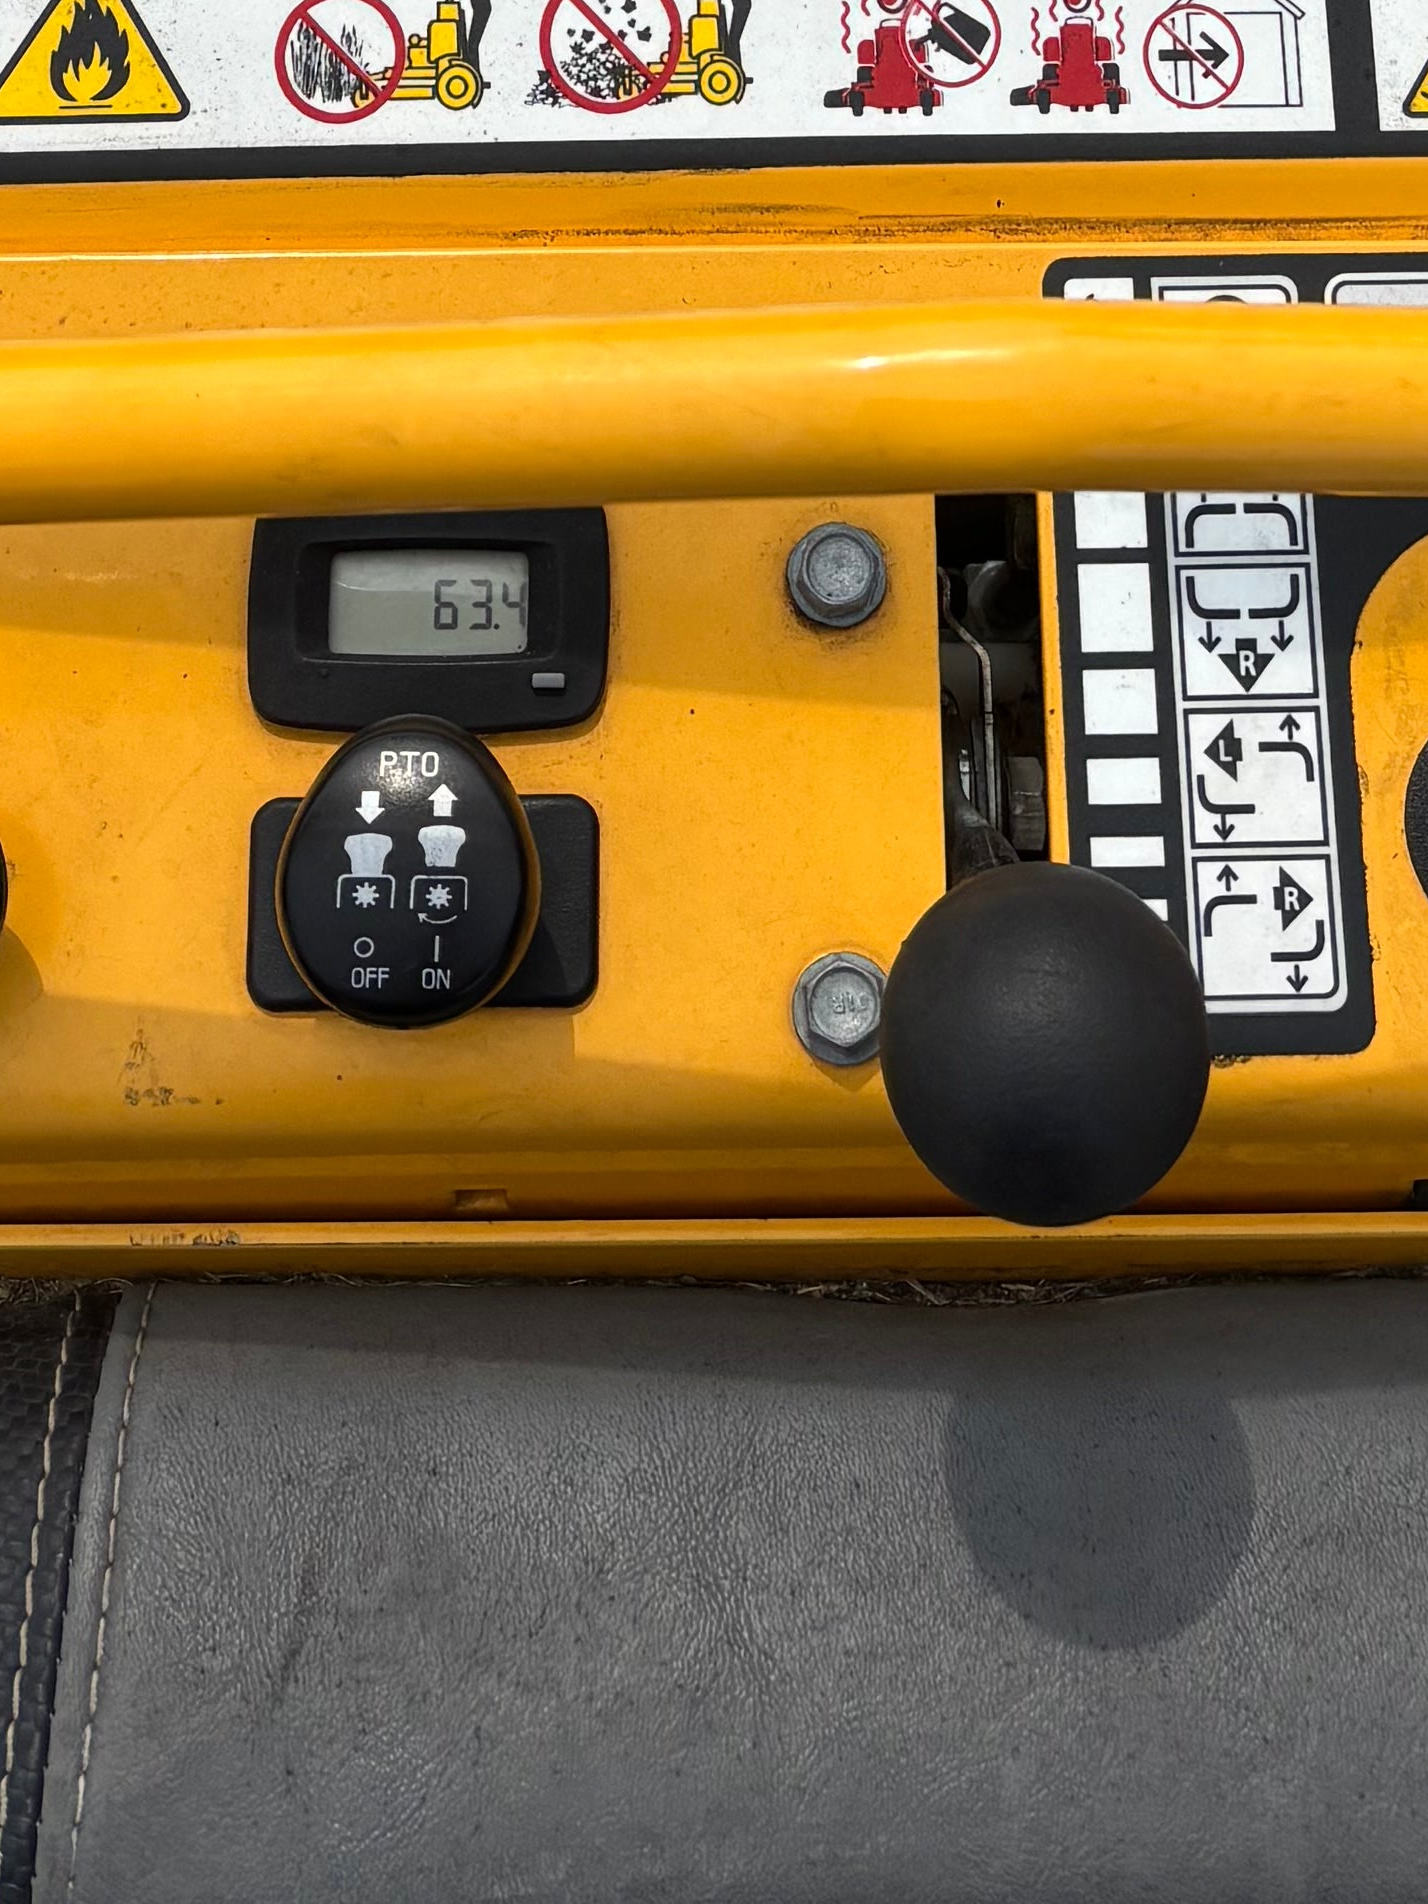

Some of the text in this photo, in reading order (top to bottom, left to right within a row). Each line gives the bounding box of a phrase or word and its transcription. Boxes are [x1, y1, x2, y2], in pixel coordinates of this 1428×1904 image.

[433, 579, 527, 630] 63.4
[1238, 649, 1257, 677] R
[1218, 739, 1233, 762] L
[379, 751, 440, 778] PTO
[1283, 886, 1301, 912] R
[351, 967, 451, 990] OFF ON
